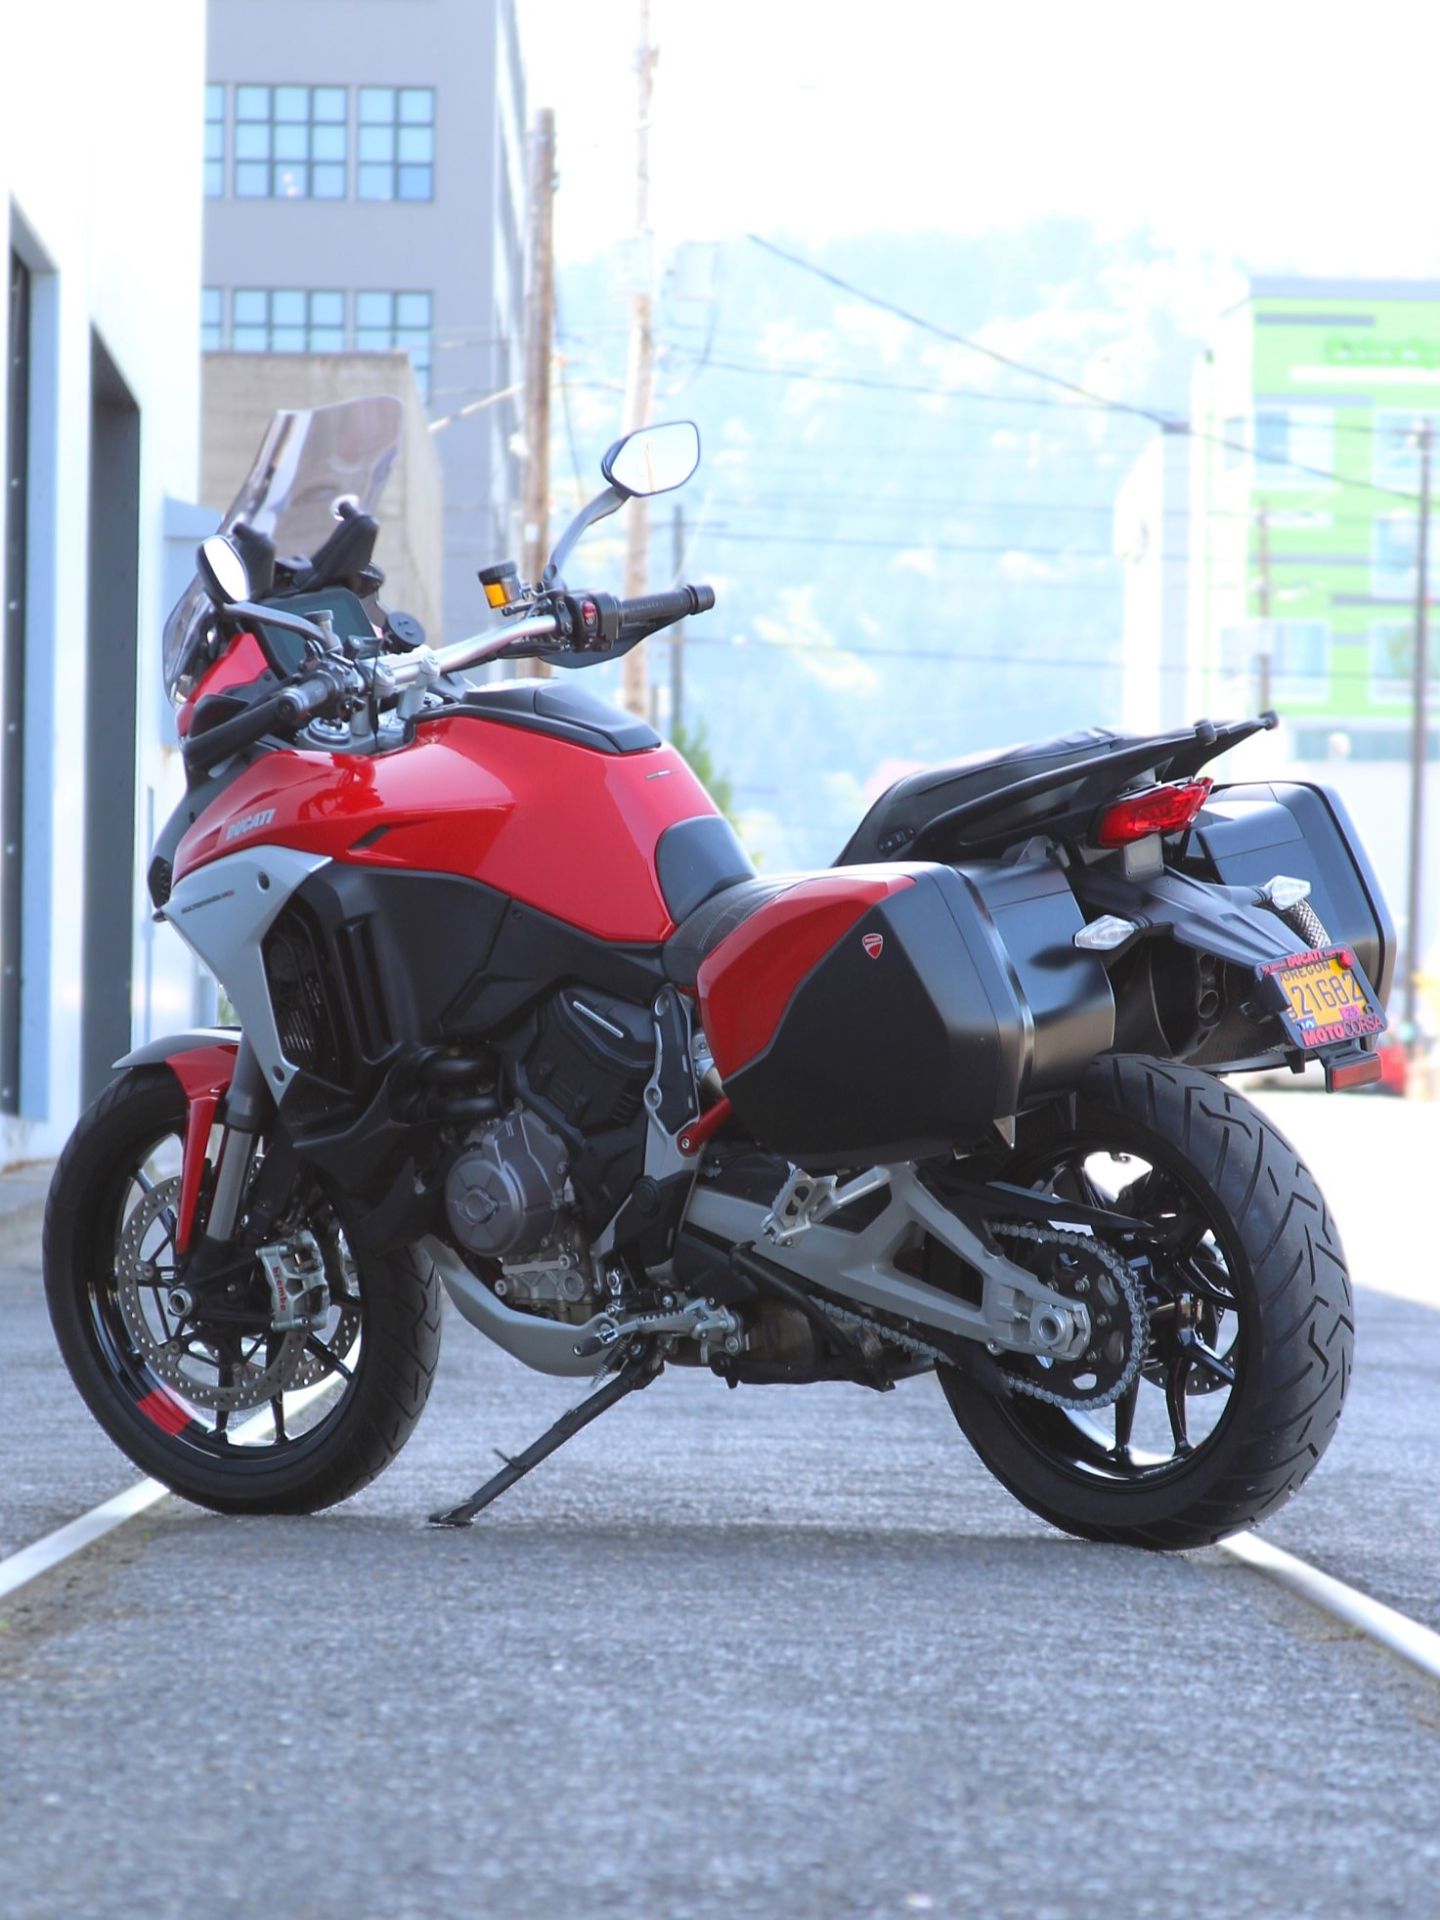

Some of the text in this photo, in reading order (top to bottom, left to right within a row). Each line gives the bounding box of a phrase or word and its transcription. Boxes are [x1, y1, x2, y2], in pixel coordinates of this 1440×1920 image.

[225, 808, 276, 841] DUCATI
[1283, 962, 1331, 982] OREGON
[1287, 951, 1323, 967] DUCATI
[1291, 973, 1364, 1016] 21682
[1301, 1014, 1384, 1047] MOTOCORSA
[272, 1266, 287, 1312] brembo
